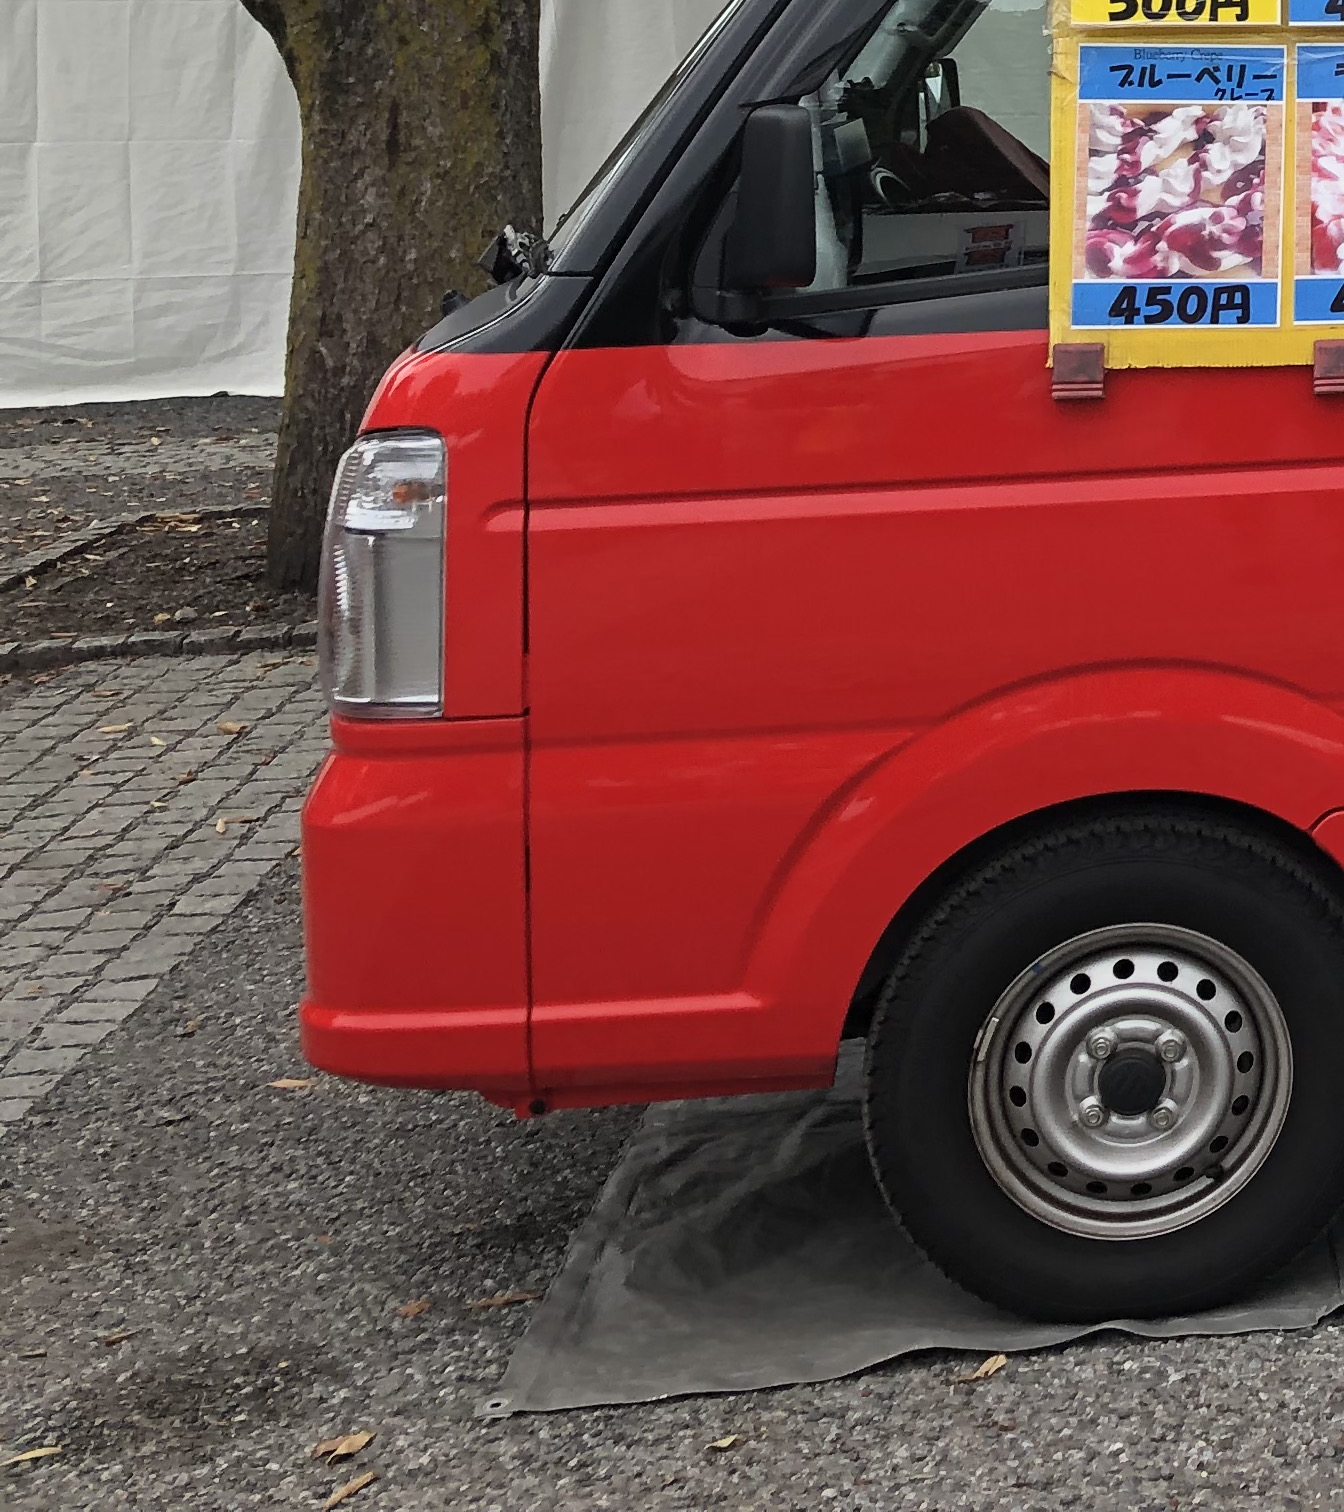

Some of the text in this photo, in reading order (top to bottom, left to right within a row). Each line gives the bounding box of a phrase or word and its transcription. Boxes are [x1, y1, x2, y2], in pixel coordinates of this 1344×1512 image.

[1109, 64, 1278, 89] ブルーベリー
[1213, 87, 1275, 101] クレープ
[1107, 285, 1250, 324] 450円
